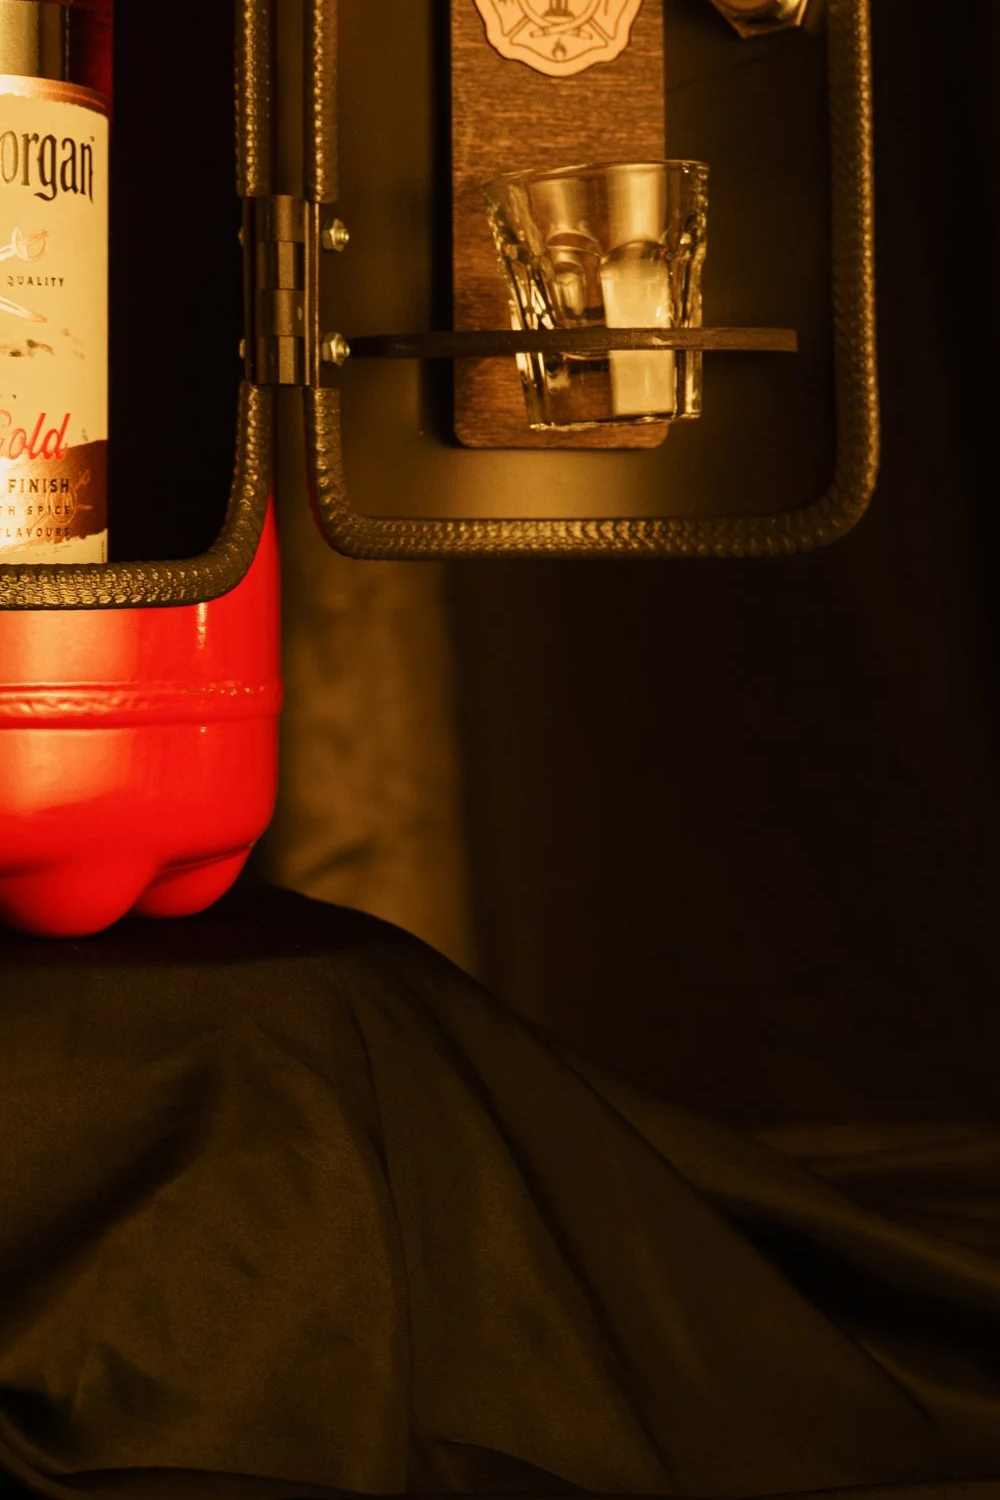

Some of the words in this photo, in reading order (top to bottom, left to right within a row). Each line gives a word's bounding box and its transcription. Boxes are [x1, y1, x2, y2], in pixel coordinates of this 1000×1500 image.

[7, 275, 65, 287] QUALITY
[7, 478, 70, 493] FINISH
[26, 505, 71, 516] SPICE
